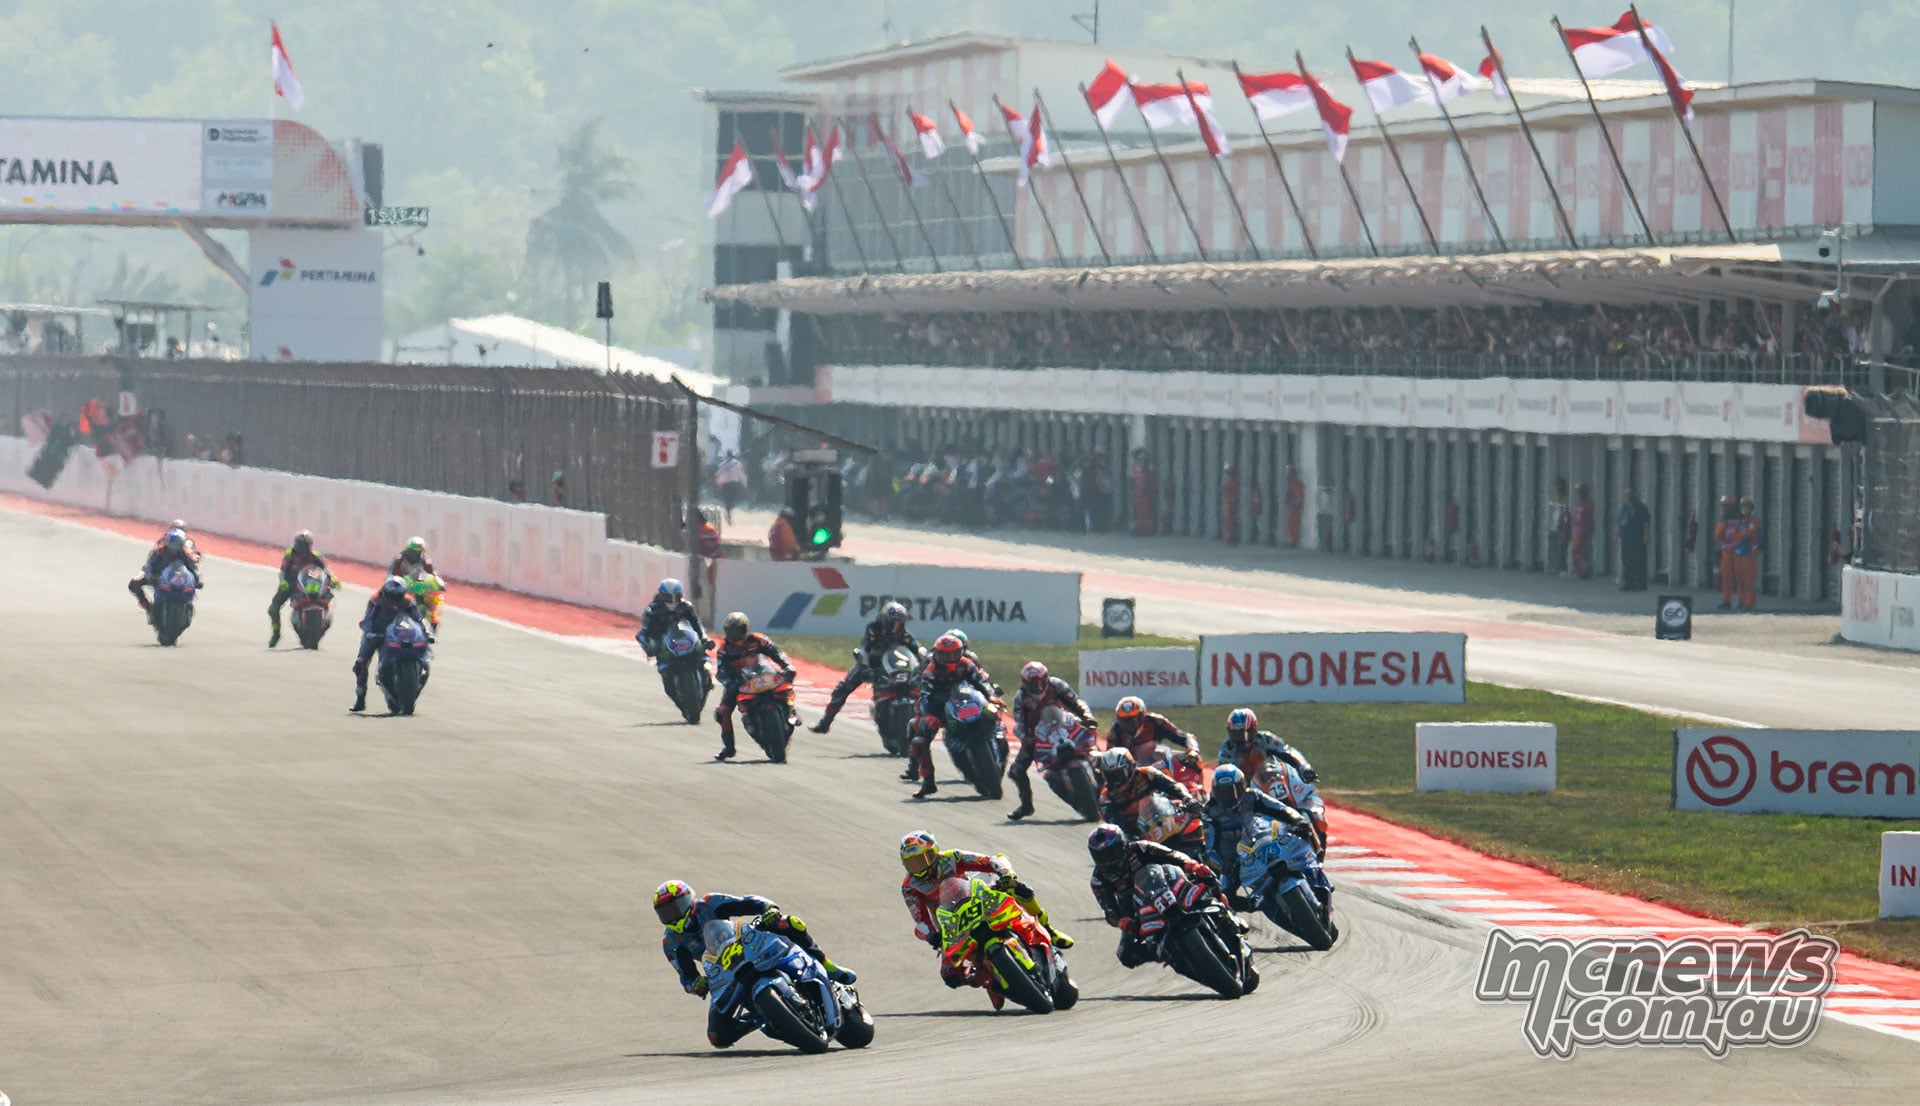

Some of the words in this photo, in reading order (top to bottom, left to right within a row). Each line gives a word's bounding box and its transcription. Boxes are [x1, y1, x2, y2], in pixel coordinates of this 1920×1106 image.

[301, 270, 375, 283] PERTAMINA
[1085, 669, 1191, 687] INDONESIA
[1211, 650, 1455, 688] INDONESIA
[753, 677, 770, 689] 23
[1426, 750, 1548, 768] INDONESIA
[1770, 750, 1920, 795] brem
[1891, 864, 1920, 887] IN
[959, 901, 983, 931] 49
